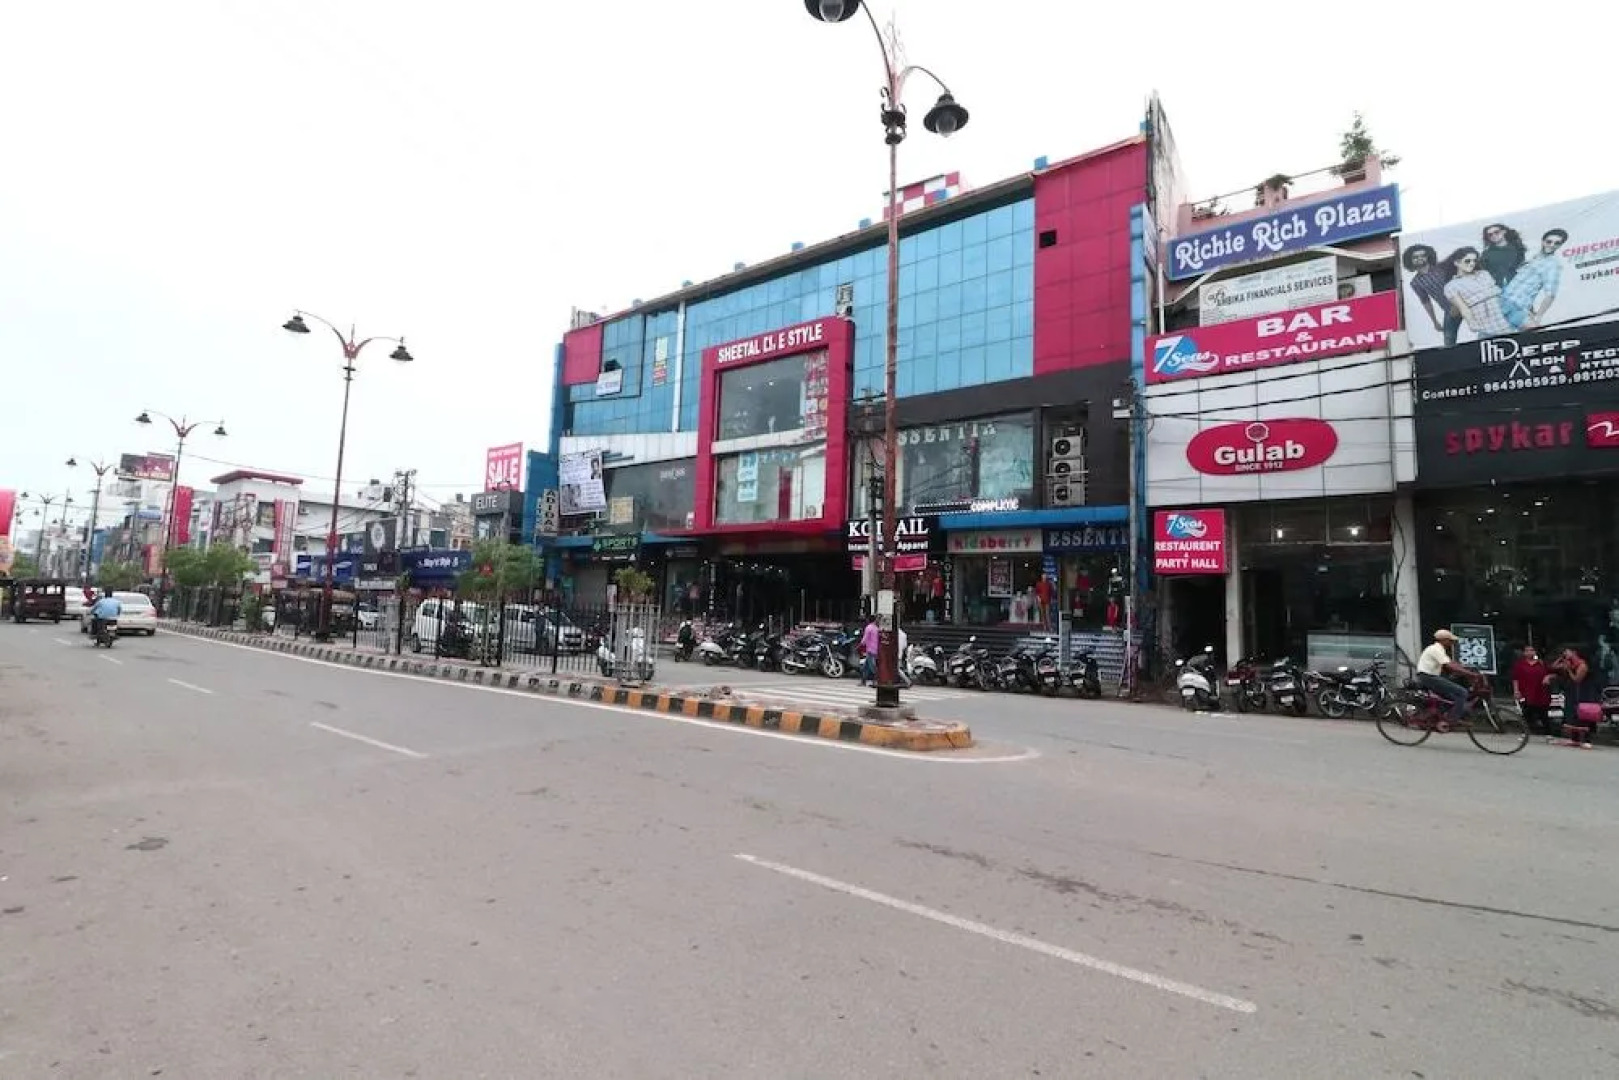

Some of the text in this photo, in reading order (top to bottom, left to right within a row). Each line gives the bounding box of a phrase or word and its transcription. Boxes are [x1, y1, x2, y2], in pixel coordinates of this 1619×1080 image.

[1176, 230, 1245, 270] Richie
[1253, 214, 1308, 251] Rich
[1314, 199, 1392, 237] Plaza
[1294, 274, 1334, 291] SERVICES
[1257, 305, 1352, 337] BAR
[719, 339, 761, 362] SHEETAL
[788, 323, 822, 346] STYLE
[1225, 329, 1392, 366] RESTAURANT
[1295, 332, 1313, 342] &
[1153, 335, 1183, 373] 7
[1422, 385, 1477, 400] Contact:
[897, 421, 997, 446] SSENTIA
[1445, 421, 1573, 456] spykar
[1214, 440, 1305, 466] Gulab
[1167, 514, 1180, 534] 7
[897, 541, 929, 553] Apparel
[954, 533, 1032, 549] kidsberry
[1155, 541, 1221, 551] RESTAURENT
[1156, 558, 1218, 568] PARTY HALL
